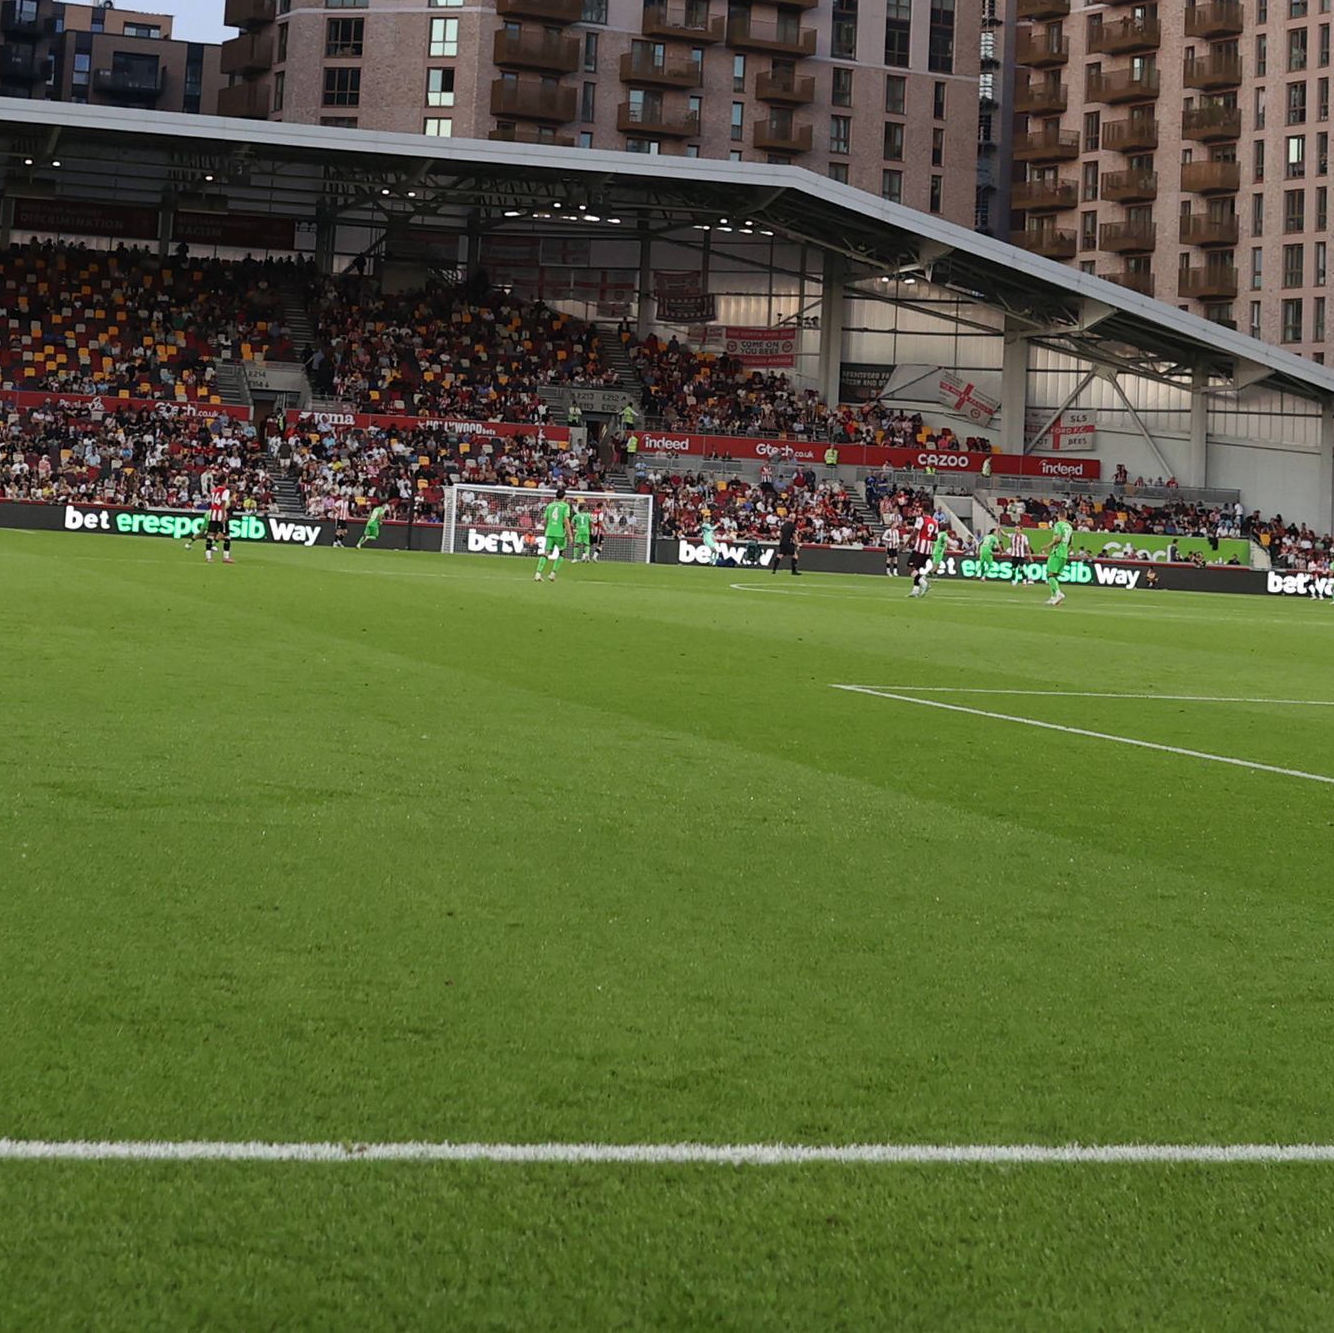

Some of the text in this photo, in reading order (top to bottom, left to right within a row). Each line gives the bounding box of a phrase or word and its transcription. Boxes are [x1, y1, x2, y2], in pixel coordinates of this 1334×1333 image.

[643, 434, 689, 451] indeed
[917, 453, 969, 468] CAZOO
[1039, 460, 1084, 476] indeed
[211, 491, 222, 506] 14
[64, 506, 111, 530] bet
[552, 507, 559, 522] 4
[926, 523, 935, 539] 9
